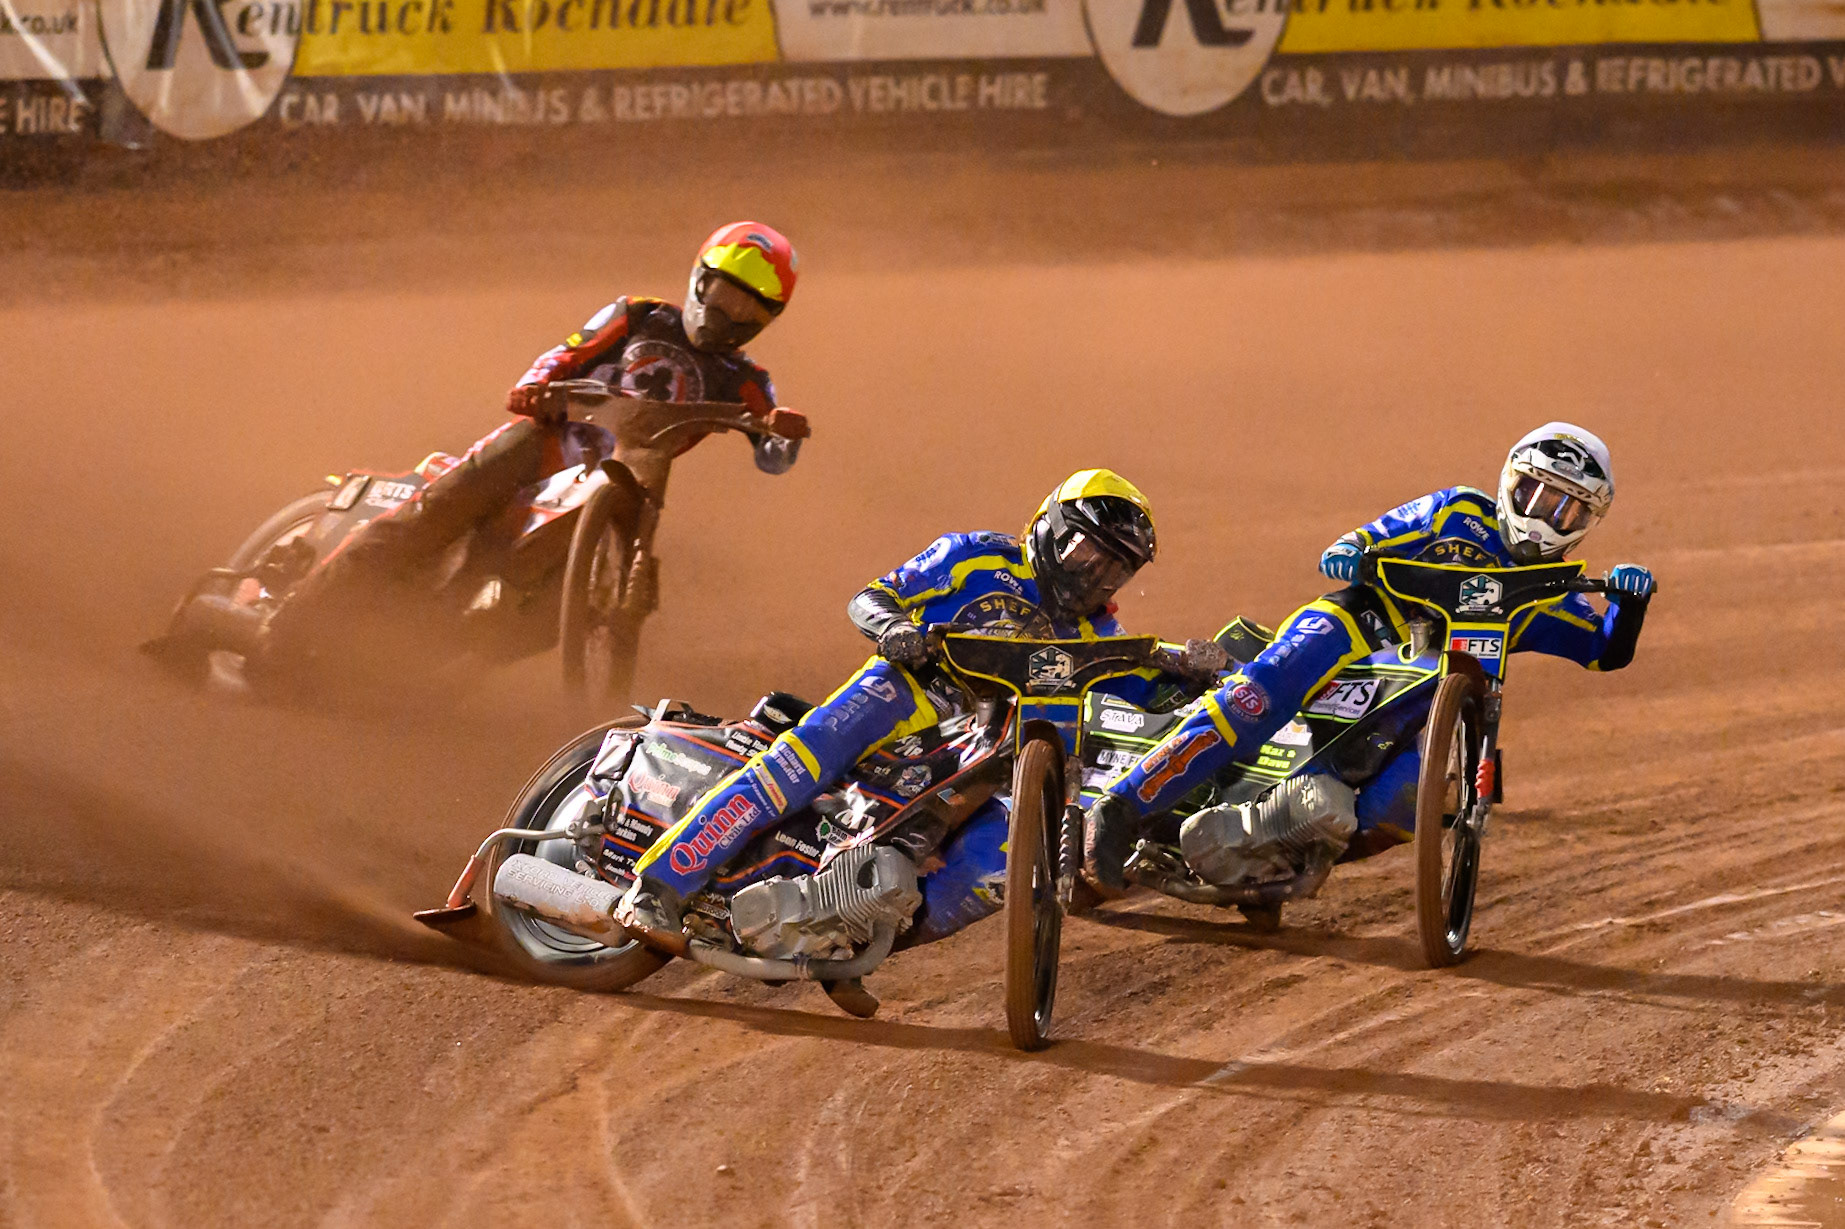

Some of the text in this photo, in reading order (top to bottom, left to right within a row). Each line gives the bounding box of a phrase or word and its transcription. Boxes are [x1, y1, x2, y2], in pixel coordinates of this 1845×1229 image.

[978, 72, 1049, 109] HIRE
[16, 96, 83, 133] HIRE
[1463, 516, 1490, 541] ROWE
[1468, 639, 1500, 652] FTS
[1236, 688, 1259, 709] STS
[1327, 680, 1374, 705] FTS
[670, 793, 756, 876] Quinn
[719, 807, 761, 850] Civils Ltd
[507, 869, 574, 897] SERVICING
